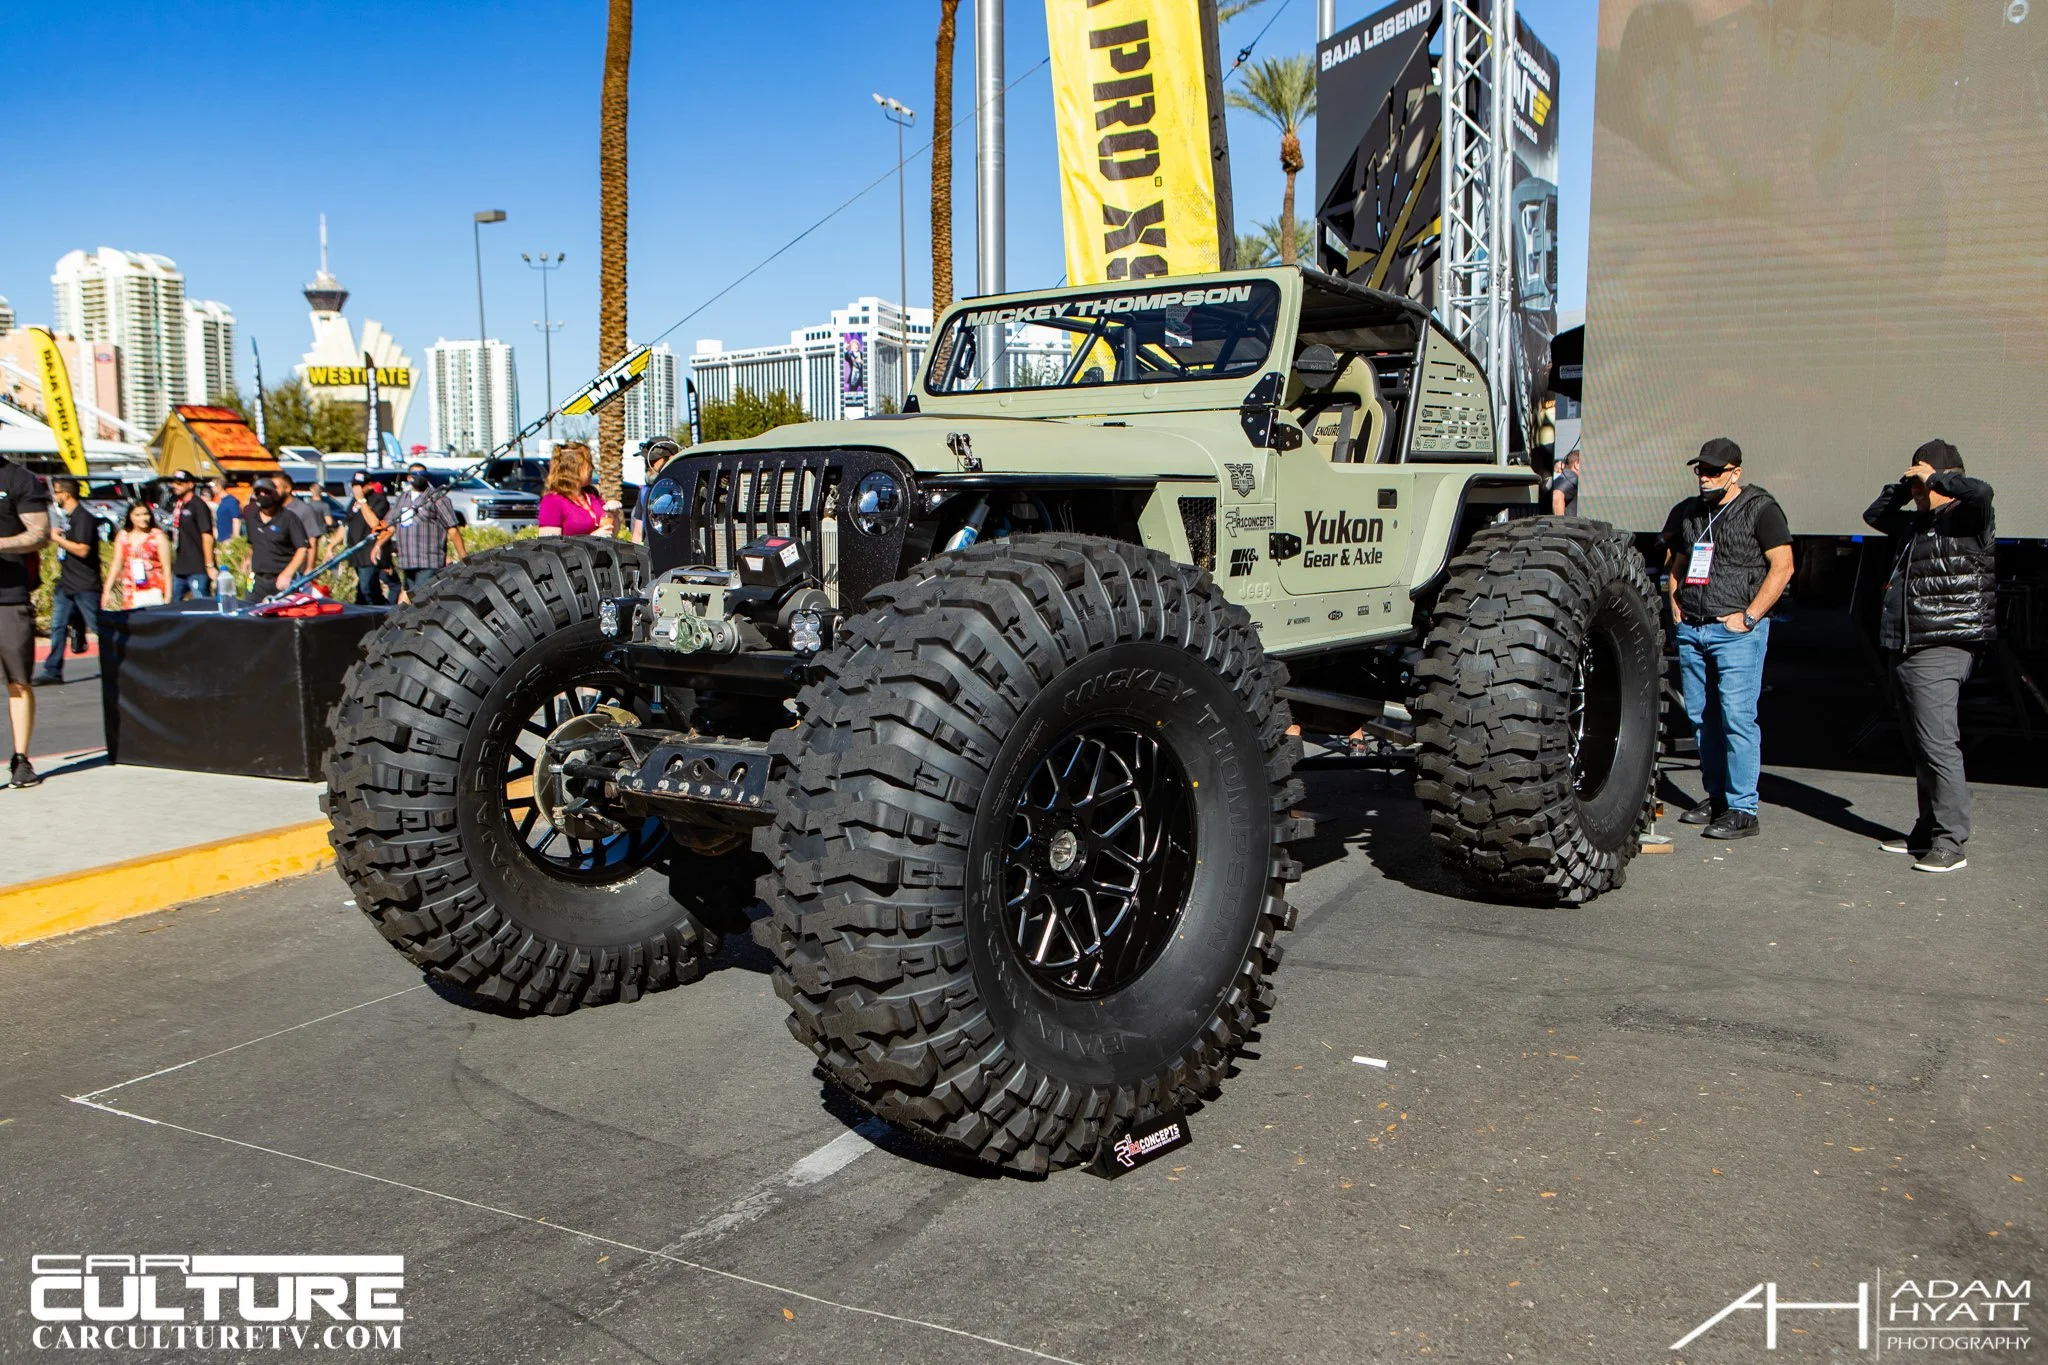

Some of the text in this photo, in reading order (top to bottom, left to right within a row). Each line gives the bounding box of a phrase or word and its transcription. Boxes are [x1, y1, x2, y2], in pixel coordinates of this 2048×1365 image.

[1321, 1, 1432, 72] BAJA LEGEND
[1089, 19, 1161, 182] PRO
[964, 285, 1252, 327] MICKEY THOMPSON
[43, 349, 58, 392] BAJA
[587, 363, 633, 405] M/T
[1237, 515, 1274, 528] R1CONCEPTS
[1304, 510, 1383, 545] Yukon
[1303, 547, 1383, 568] Gear & Axle
[1239, 580, 1271, 600] Jeep
[1062, 667, 1250, 953] MICKEY THOMPSON
[1129, 1123, 1180, 1156] R1CONCEPTS
